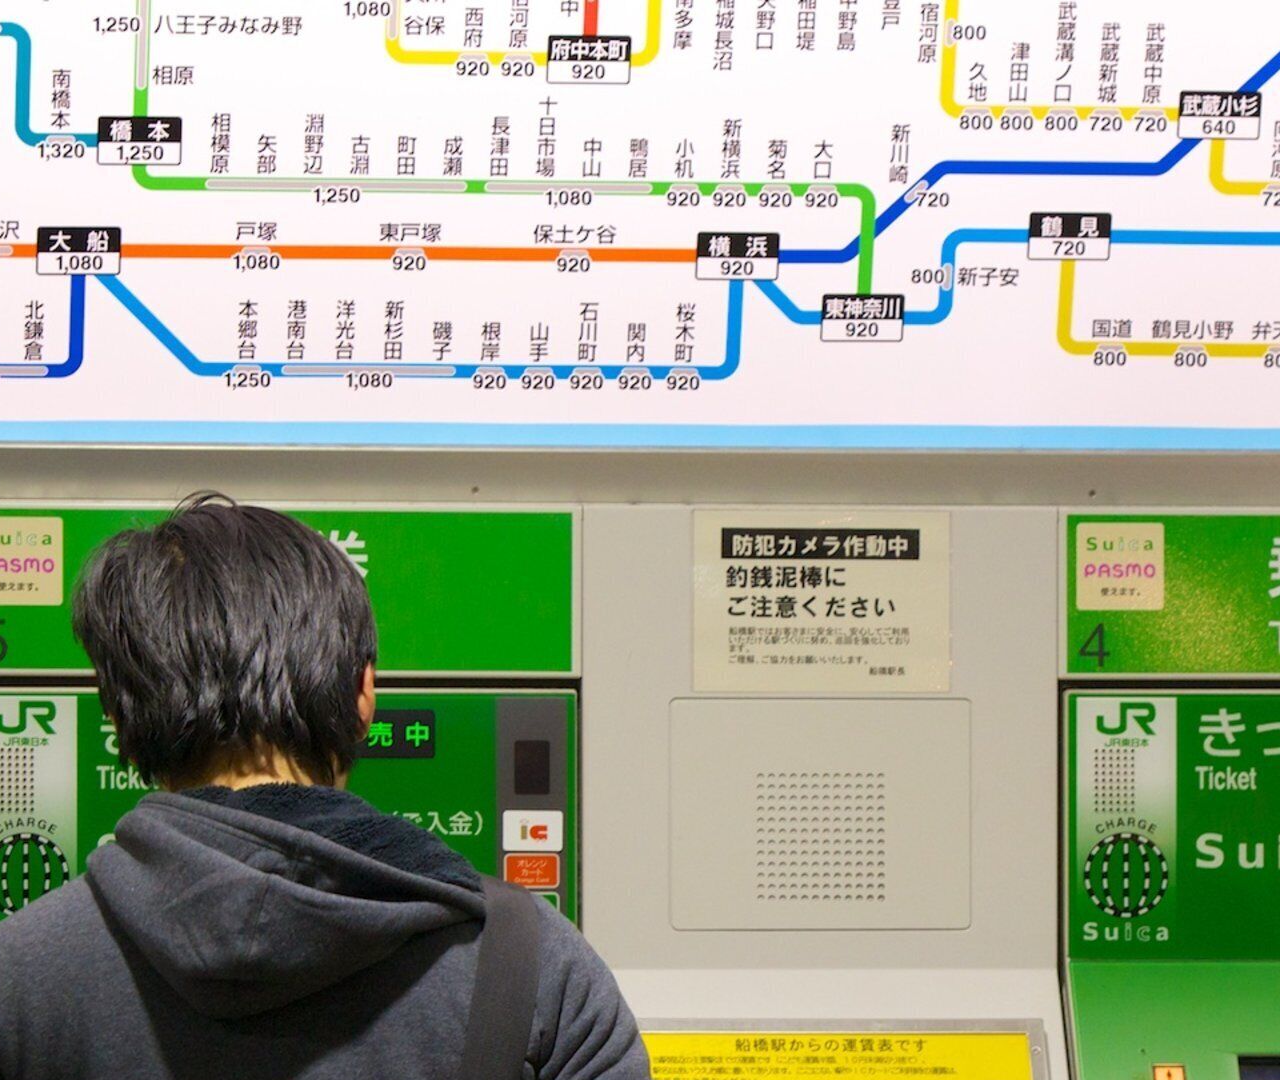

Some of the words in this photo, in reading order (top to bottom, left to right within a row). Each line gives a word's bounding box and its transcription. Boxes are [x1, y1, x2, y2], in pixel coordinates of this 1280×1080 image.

[155, 16, 301, 36] 八王子みなみ野
[551, 39, 628, 60] 府中本町
[1143, 26, 1164, 103] 武蔵中原
[51, 69, 70, 128] 南橋本
[1182, 95, 1258, 117] 武蔵小杉
[110, 120, 168, 142] 橋本
[1135, 117, 1167, 131] 720
[38, 144, 84, 160] 1,320
[210, 114, 230, 173] 相模原
[491, 117, 509, 176] 長津田
[350, 136, 369, 174] 古淵
[583, 139, 601, 177] 中山
[768, 140, 787, 179] 菊名
[713, 193, 746, 207] 920
[236, 222, 276, 240] 戸塚
[1042, 216, 1099, 237] 鶴見
[49, 231, 110, 252] 大船
[709, 236, 768, 257] 横浜
[393, 256, 426, 270] 920
[911, 269, 944, 284] 800
[958, 268, 1018, 286] 新子安
[825, 298, 900, 319] 東神奈川
[238, 300, 257, 359] 本郷台
[336, 301, 355, 359] 洋光台
[579, 303, 598, 362] 石川町
[1153, 320, 1233, 340] 鶴見小野
[481, 323, 500, 361] 根岸
[347, 373, 392, 390] 1,080
[667, 376, 699, 390] 920
[731, 534, 909, 557] 防犯カメラ作動中
[1086, 537, 1154, 552] Suica
[726, 565, 846, 589] 釣銭泥棒に
[1084, 563, 1157, 580] PASMO
[726, 596, 896, 619] ご注意ください
[1079, 623, 1110, 667] 4
[1096, 702, 1157, 735] JR
[1195, 766, 1257, 791] Ticket
[1095, 817, 1159, 835] CHARGE
[1082, 922, 1169, 942] Suica
[735, 1038, 928, 1053] 船橋駅からの運賃表です
